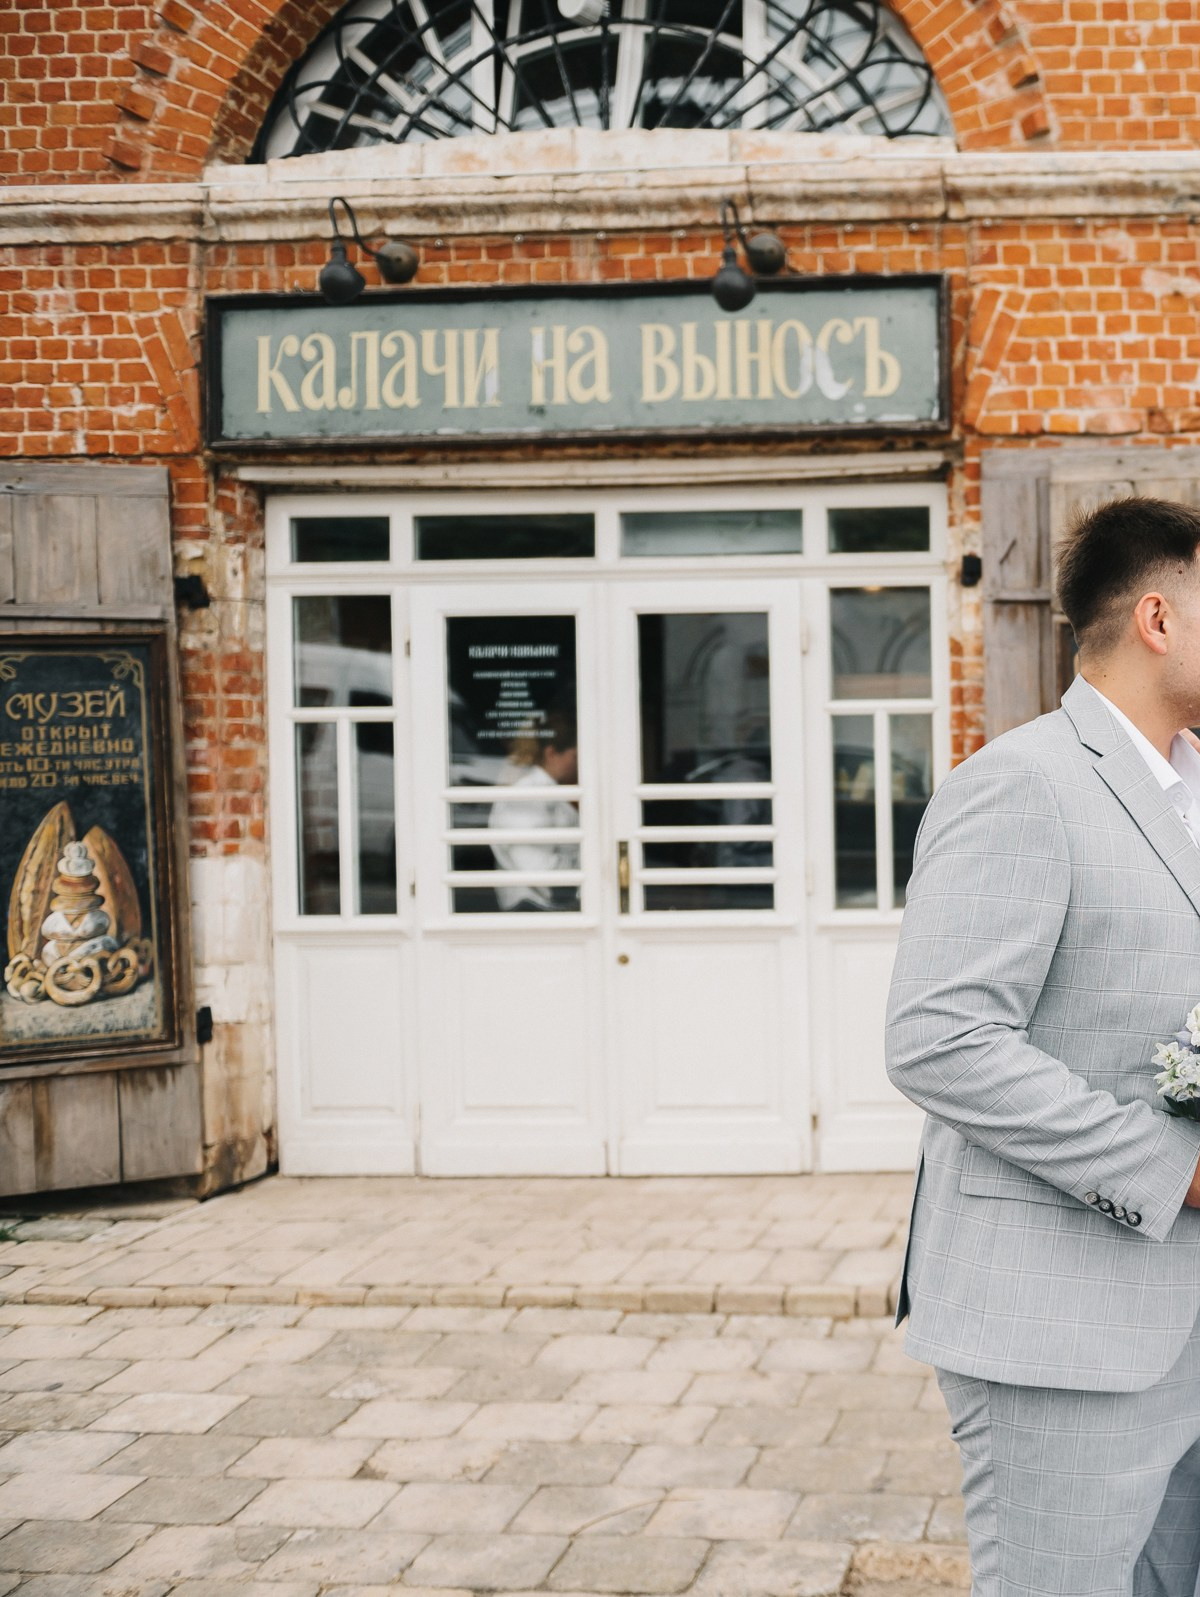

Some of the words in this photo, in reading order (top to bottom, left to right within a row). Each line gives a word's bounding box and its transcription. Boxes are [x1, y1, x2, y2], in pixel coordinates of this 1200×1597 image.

[5, 684, 126, 724] МУЗЕЙ
[21, 723, 111, 741] ОТКРЫТ
[0, 738, 134, 756] ЕЖЕДНЕВНО
